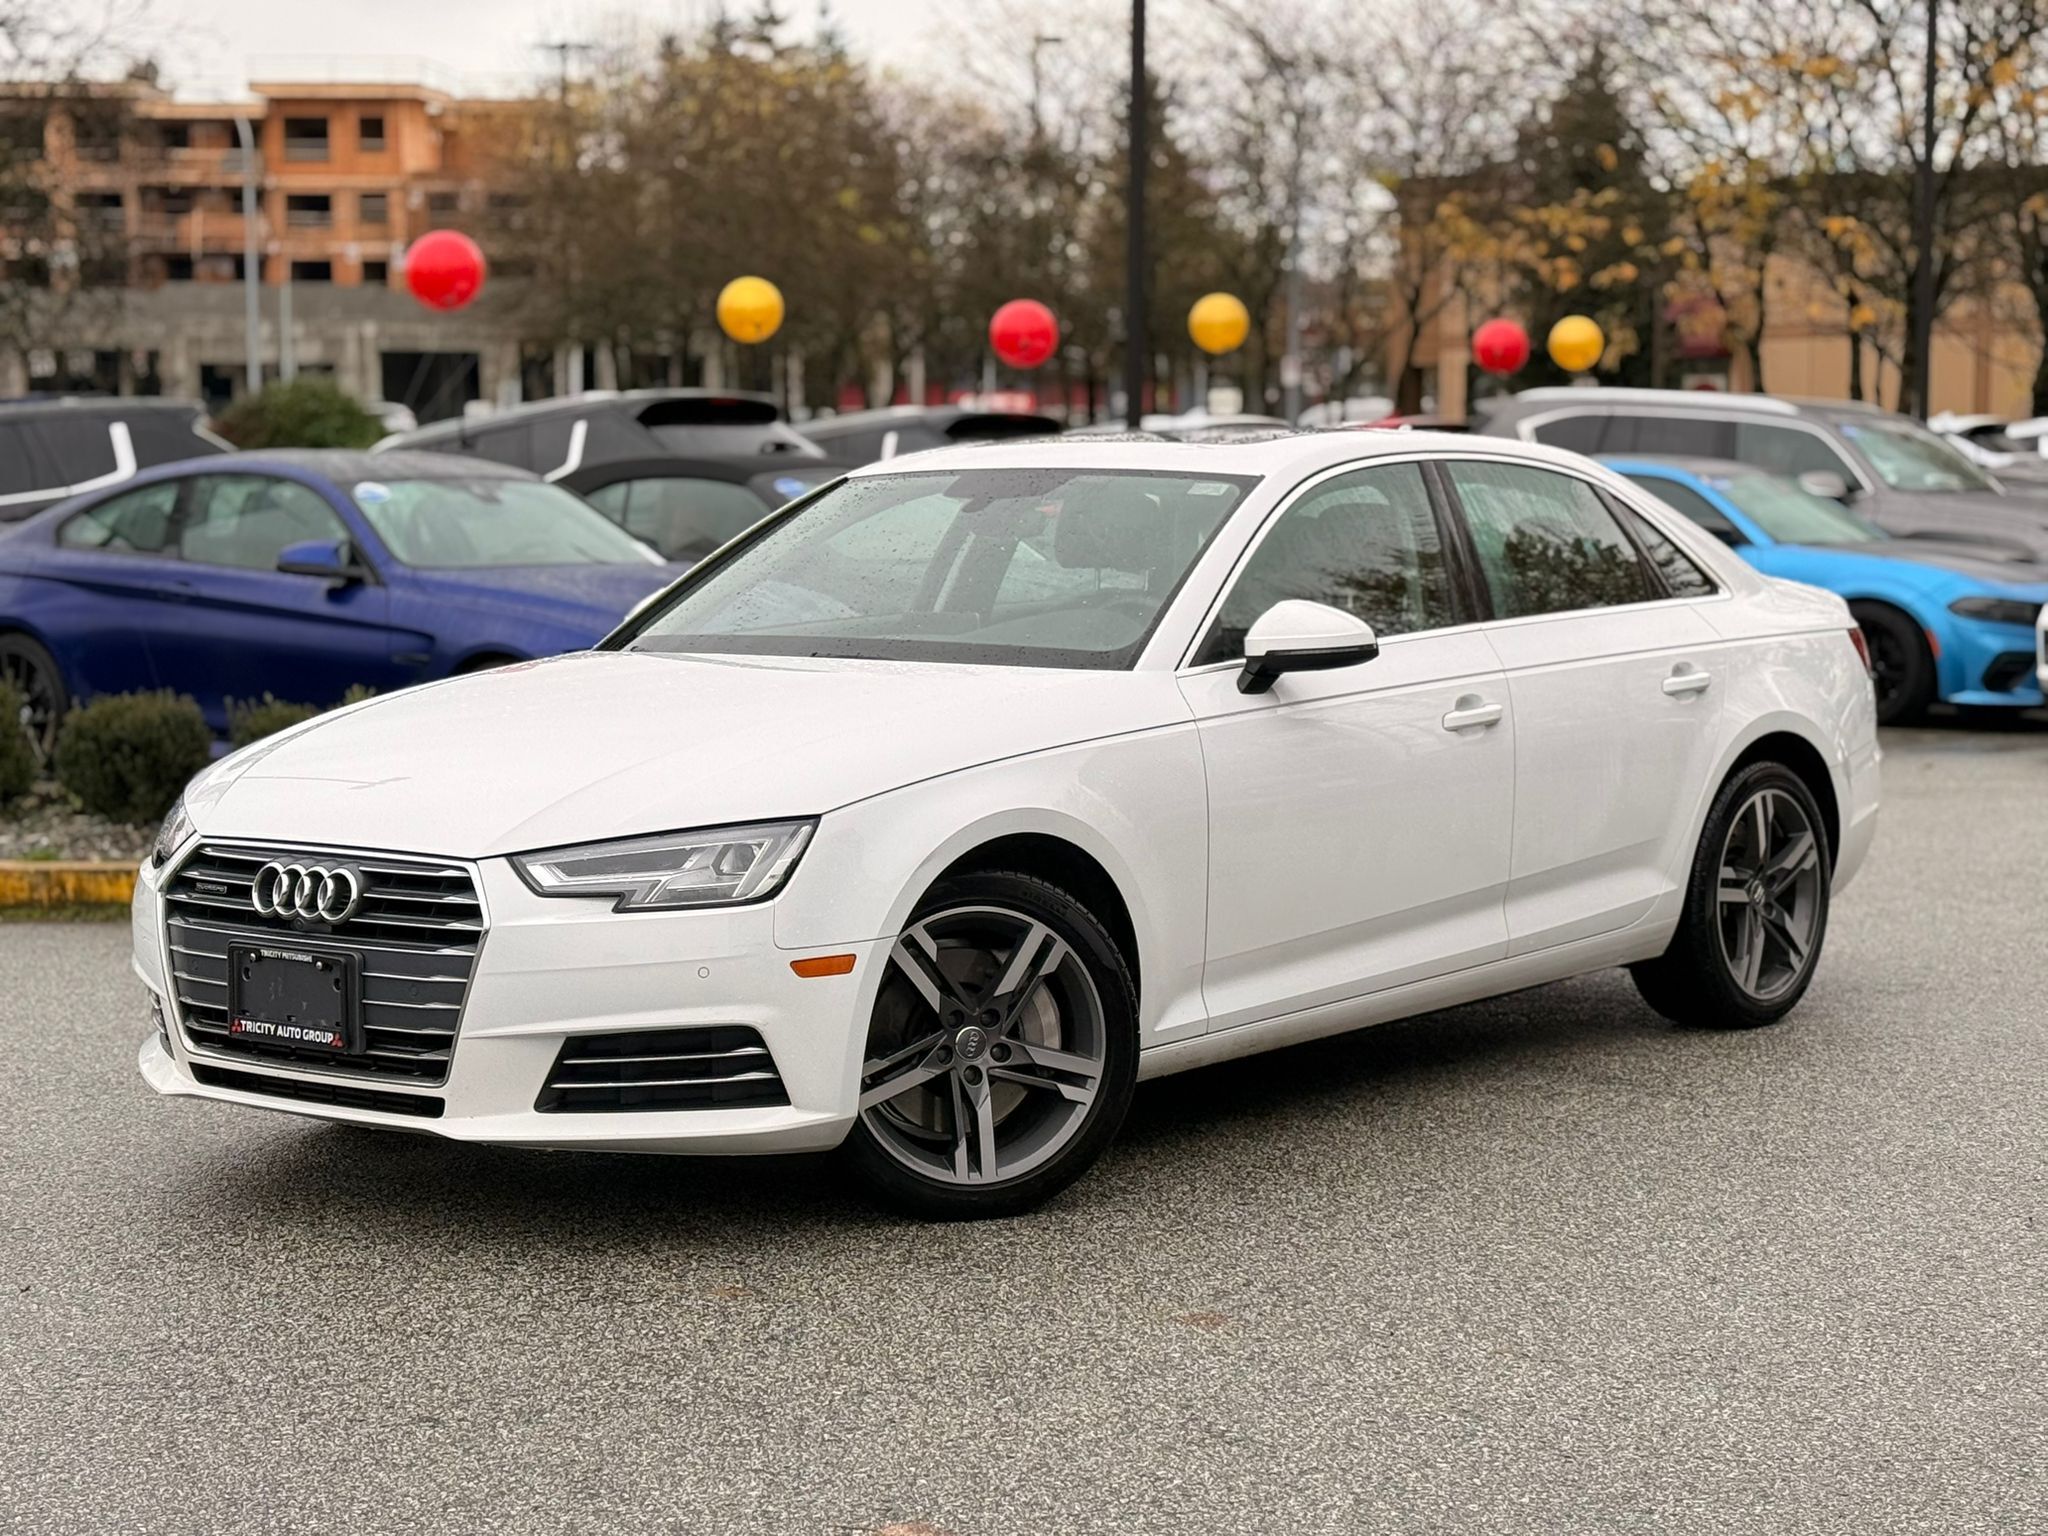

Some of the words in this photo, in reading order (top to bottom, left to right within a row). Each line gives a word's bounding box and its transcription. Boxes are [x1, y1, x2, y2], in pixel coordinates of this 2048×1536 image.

[260, 949, 281, 959] TRICITY
[240, 1020, 276, 1035] TRICITY
[277, 1026, 301, 1039] AUTO
[303, 1031, 333, 1044] GROUP
